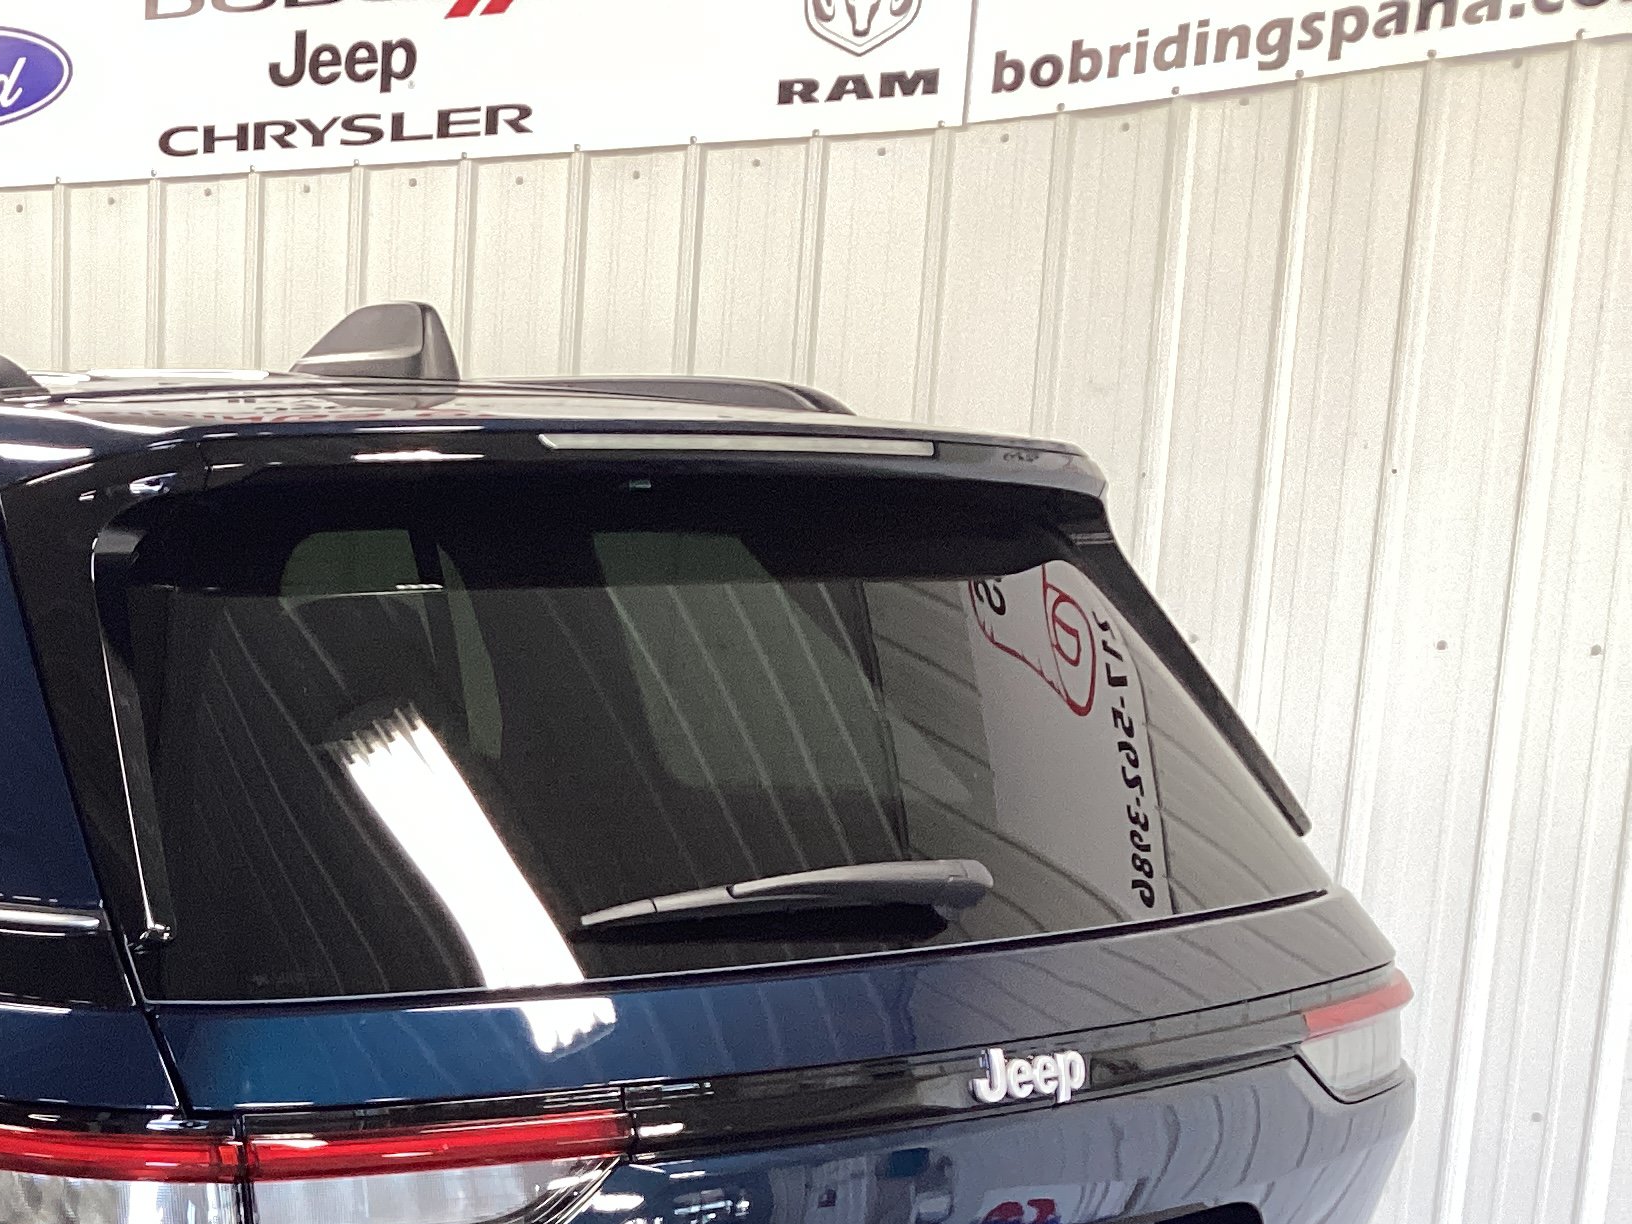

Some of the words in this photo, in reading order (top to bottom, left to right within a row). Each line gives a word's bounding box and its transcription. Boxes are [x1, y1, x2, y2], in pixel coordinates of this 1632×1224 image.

[268, 29, 418, 94] Jeep
[991, 0, 1632, 94] bobridingspana.
[777, 67, 940, 106] RAM
[158, 103, 533, 158] CHRYSLER
[969, 1048, 1087, 1104] Jeep
